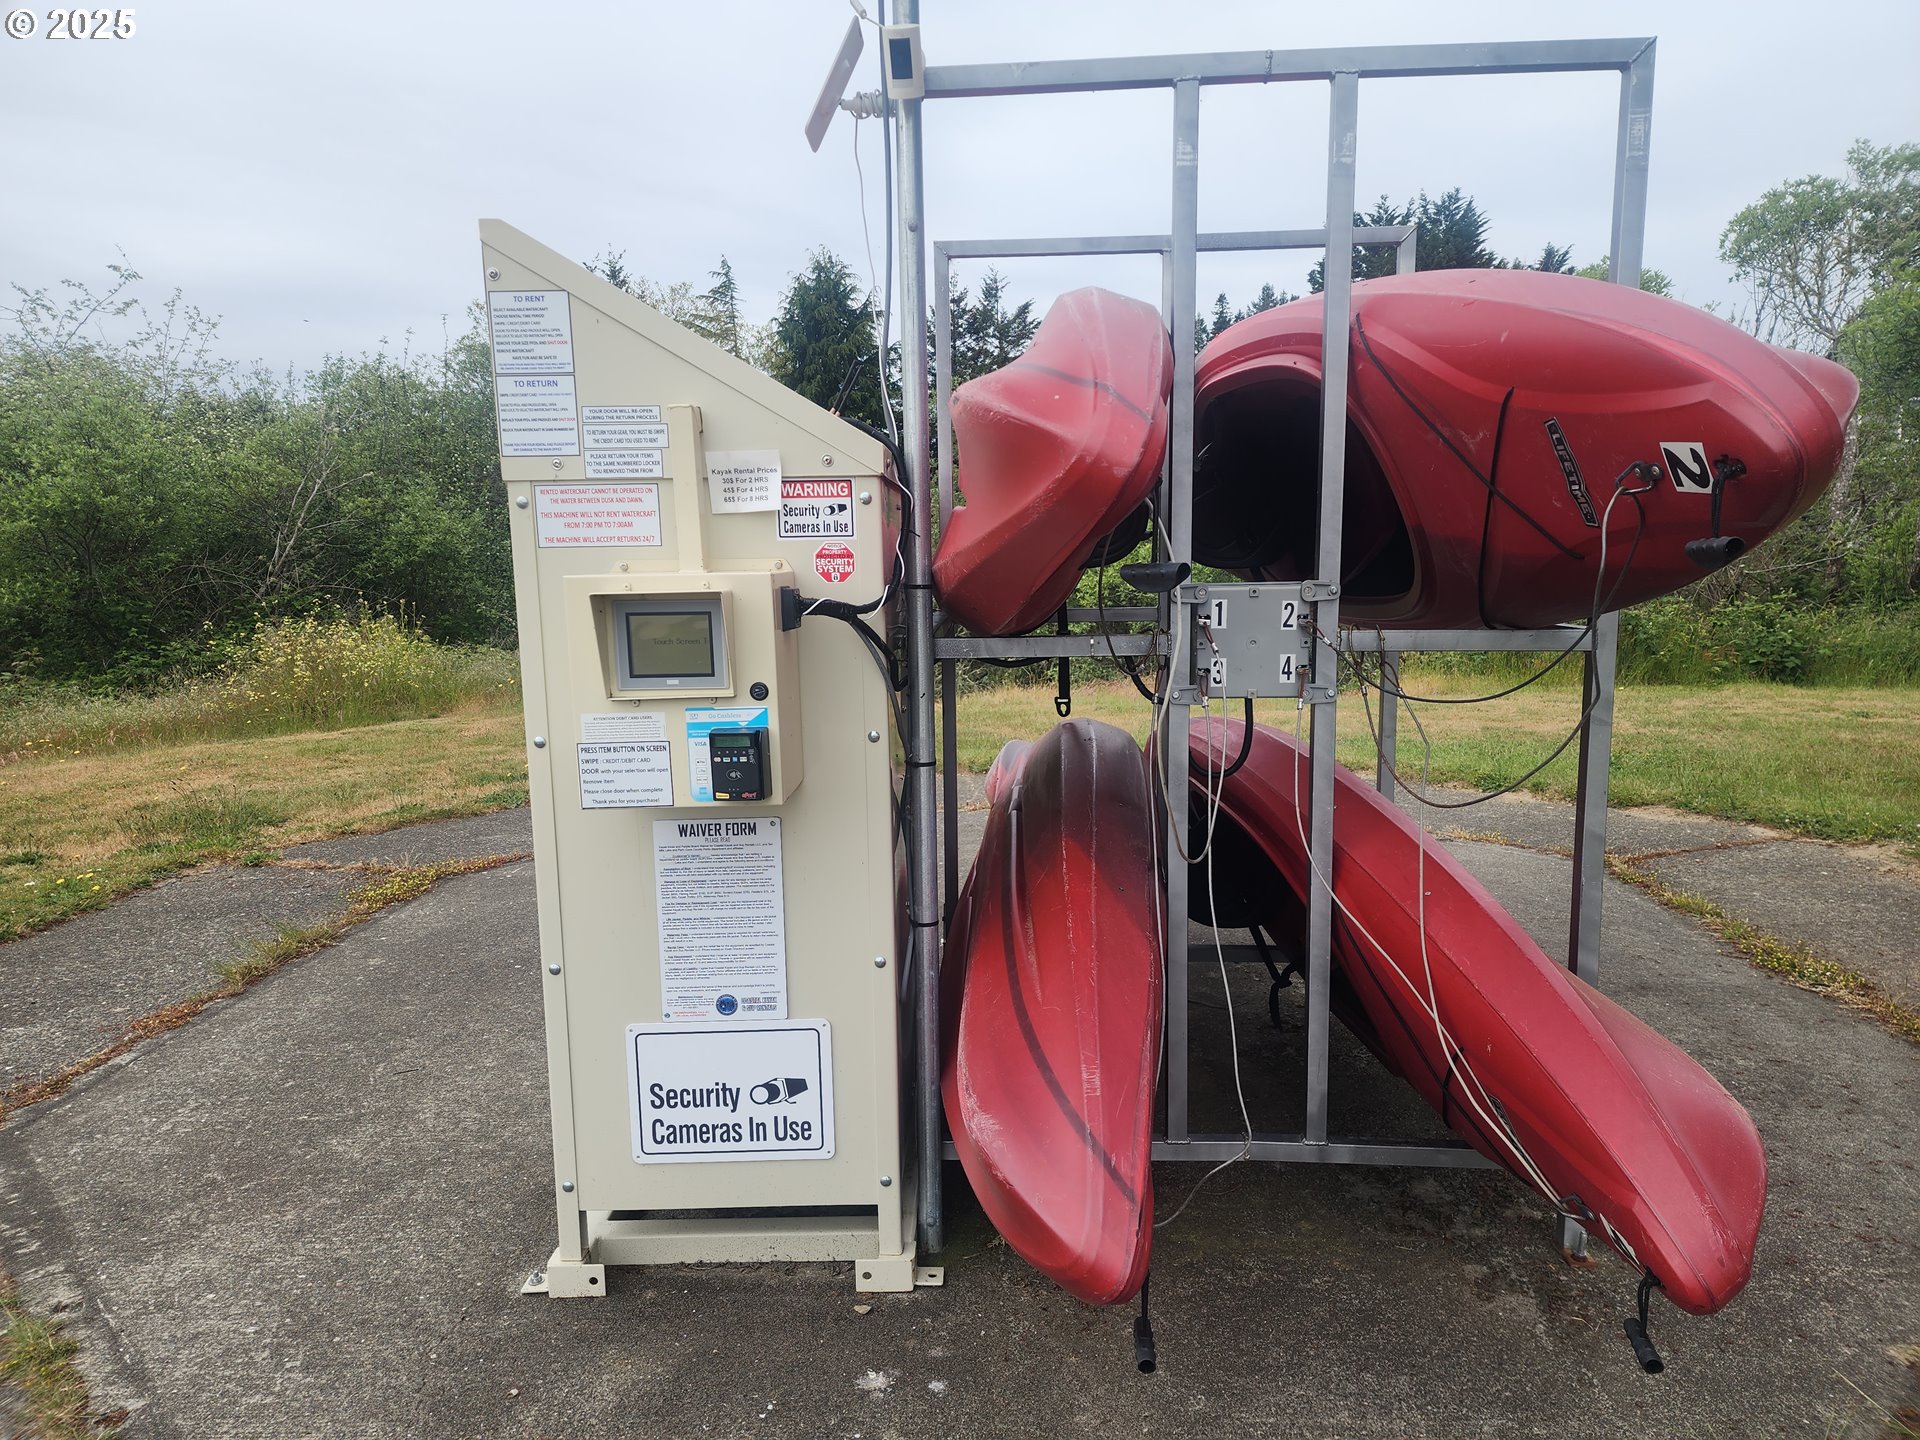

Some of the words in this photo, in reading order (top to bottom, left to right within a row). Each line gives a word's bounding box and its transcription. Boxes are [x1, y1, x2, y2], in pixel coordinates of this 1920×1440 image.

[757, 466, 777, 474] Prices
[1552, 432, 1592, 514] LIFETIME
[1663, 447, 1711, 489] 2
[781, 483, 849, 496] WARNING
[554, 511, 578, 519] MACHINE
[622, 510, 656, 518] WATERCRAFT
[783, 504, 820, 518] Security
[784, 522, 820, 533] Cameras
[823, 521, 831, 532] In
[833, 520, 849, 532] Use
[818, 565, 853, 573] SYSTEM
[1215, 601, 1223, 626] 1
[1282, 603, 1295, 628] 2
[1213, 660, 1223, 685] 3
[1281, 656, 1292, 680] 4
[598, 746, 612, 754] ITEM
[636, 745, 645, 753] ON
[678, 823, 721, 837] WAIVER
[726, 822, 757, 836] FORM
[649, 1082, 741, 1112] Security
[652, 1118, 743, 1145] Cameras
[749, 1116, 767, 1142] In
[774, 1116, 812, 1141] Use
